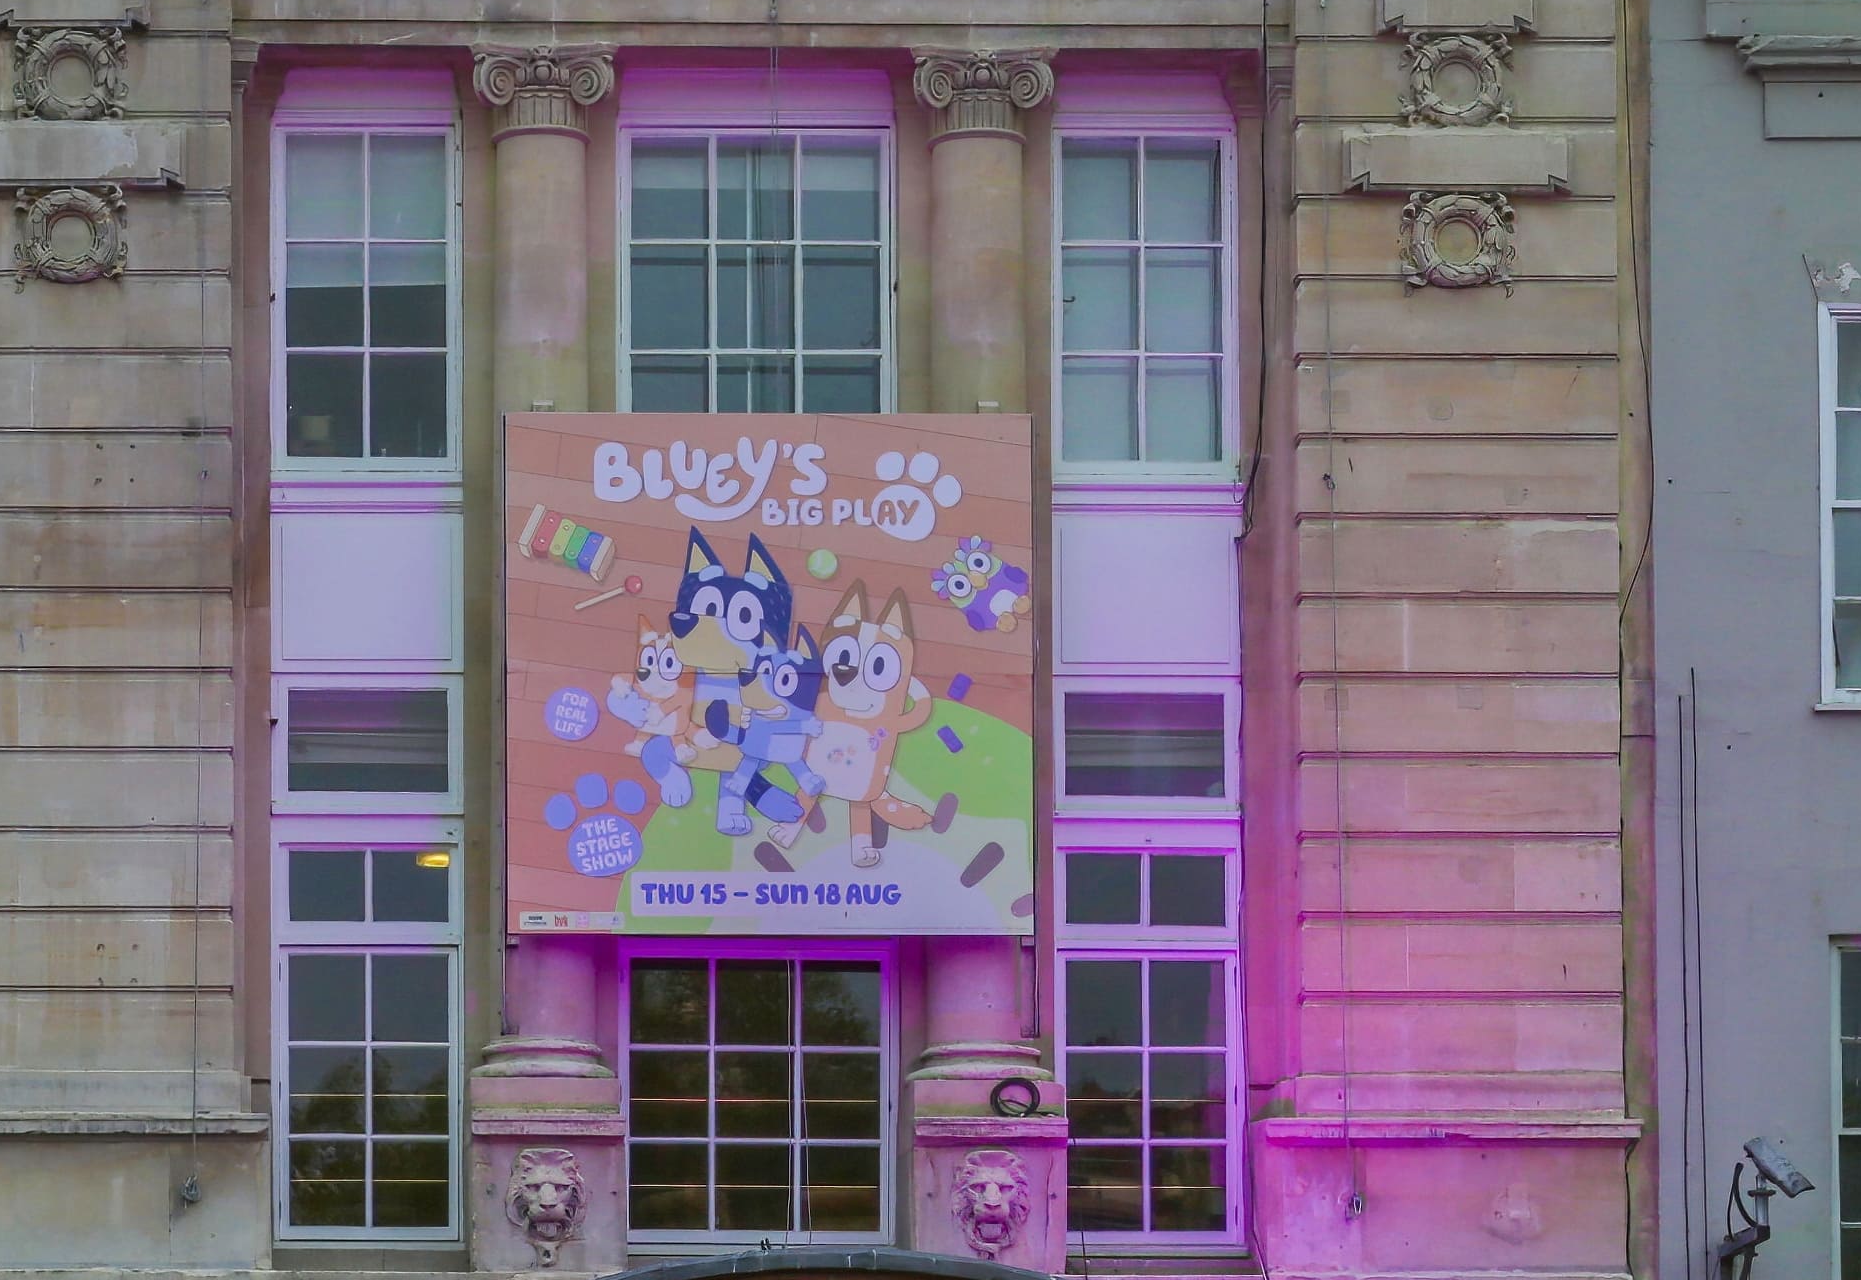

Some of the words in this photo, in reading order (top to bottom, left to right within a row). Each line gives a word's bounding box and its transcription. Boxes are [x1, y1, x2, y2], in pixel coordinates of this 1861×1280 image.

[593, 436, 828, 521] BLUEY'S
[761, 498, 824, 526] BIG
[832, 498, 921, 526] PLAY
[562, 692, 589, 708] FOR
[556, 705, 587, 723] REAL
[555, 721, 584, 737] LIFE
[581, 818, 618, 840] THE
[575, 831, 634, 858] STAGE
[581, 849, 634, 873] SHOW
[641, 883, 694, 905] THU
[700, 883, 727, 905] 15
[814, 883, 841, 905] 18
[846, 883, 902, 905] AUG
